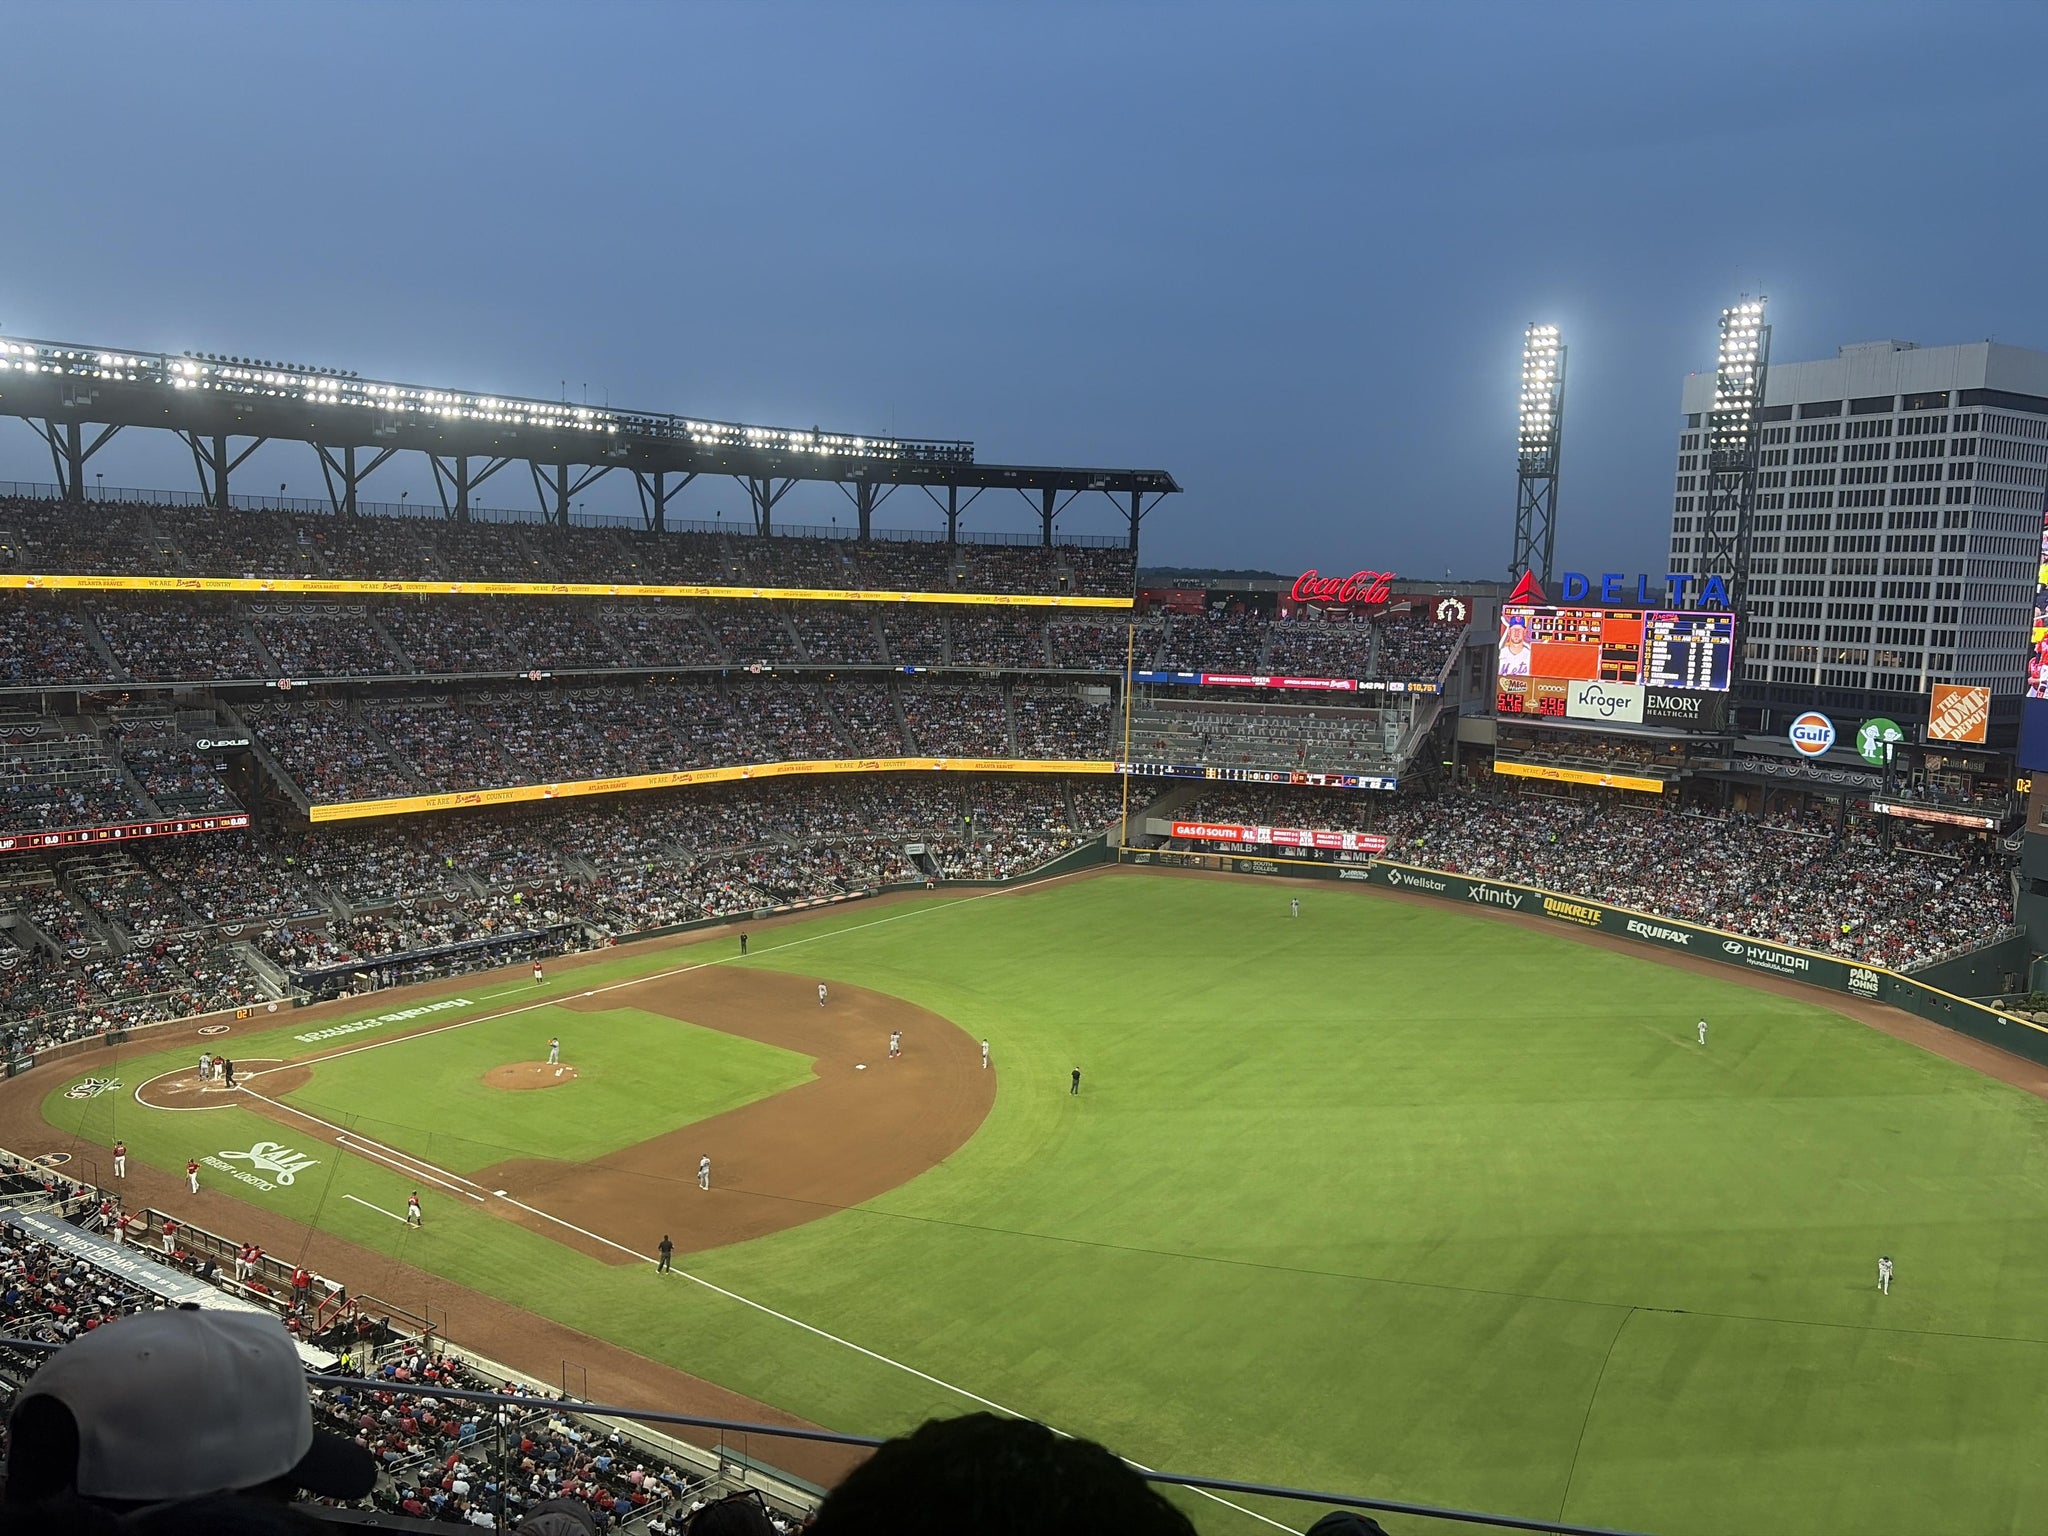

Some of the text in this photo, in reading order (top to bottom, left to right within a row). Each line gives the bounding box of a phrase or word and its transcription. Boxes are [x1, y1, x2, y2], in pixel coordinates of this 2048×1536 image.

[1291, 569, 1397, 604] Coca-Cola
[1562, 572, 1730, 606] DELTA
[278, 678, 291, 690] 41
[1374, 681, 1385, 690] PM
[1408, 683, 1437, 692] $10,751
[1498, 694, 1523, 706] 542
[1540, 698, 1565, 710] 396
[1579, 685, 1631, 716] Kroger
[1647, 695, 1702, 712] EMORY
[1936, 691, 1961, 713] THE
[1647, 708, 1699, 719] HEALTHCARE
[1930, 688, 1989, 739] HOME
[1950, 708, 1987, 741] DEPOT
[1793, 727, 1830, 741] Gulf
[1942, 760, 1984, 771] CLUBHOUSE
[455, 795, 481, 804] Braves
[486, 792, 514, 800] COUNTRY
[1985, 818, 1994, 828] 2
[1177, 826, 1195, 835] GAS
[1206, 828, 1236, 838] SOUTH
[1242, 830, 1255, 839] AL
[0, 840, 14, 848] LHP
[1231, 842, 1258, 852] MLB+
[1403, 874, 1446, 891] Wellstar
[1468, 884, 1523, 909] xfinity
[1543, 897, 1602, 921] QUIKRETE
[1626, 920, 1689, 944] EQUIFAX
[1747, 946, 1809, 970] HYUNDAI
[1747, 958, 1794, 974] HyundaiUSA.com
[1850, 968, 1878, 983] PAPA
[1848, 978, 1878, 992] JOHNS
[200, 1156, 277, 1191] FREIGHT LOGISTICS
[21, 1216, 50, 1230] WELCOME
[56, 1231, 142, 1273] TRUIST PARK
[138, 1270, 156, 1282] HOME
[168, 1282, 183, 1291] THE
